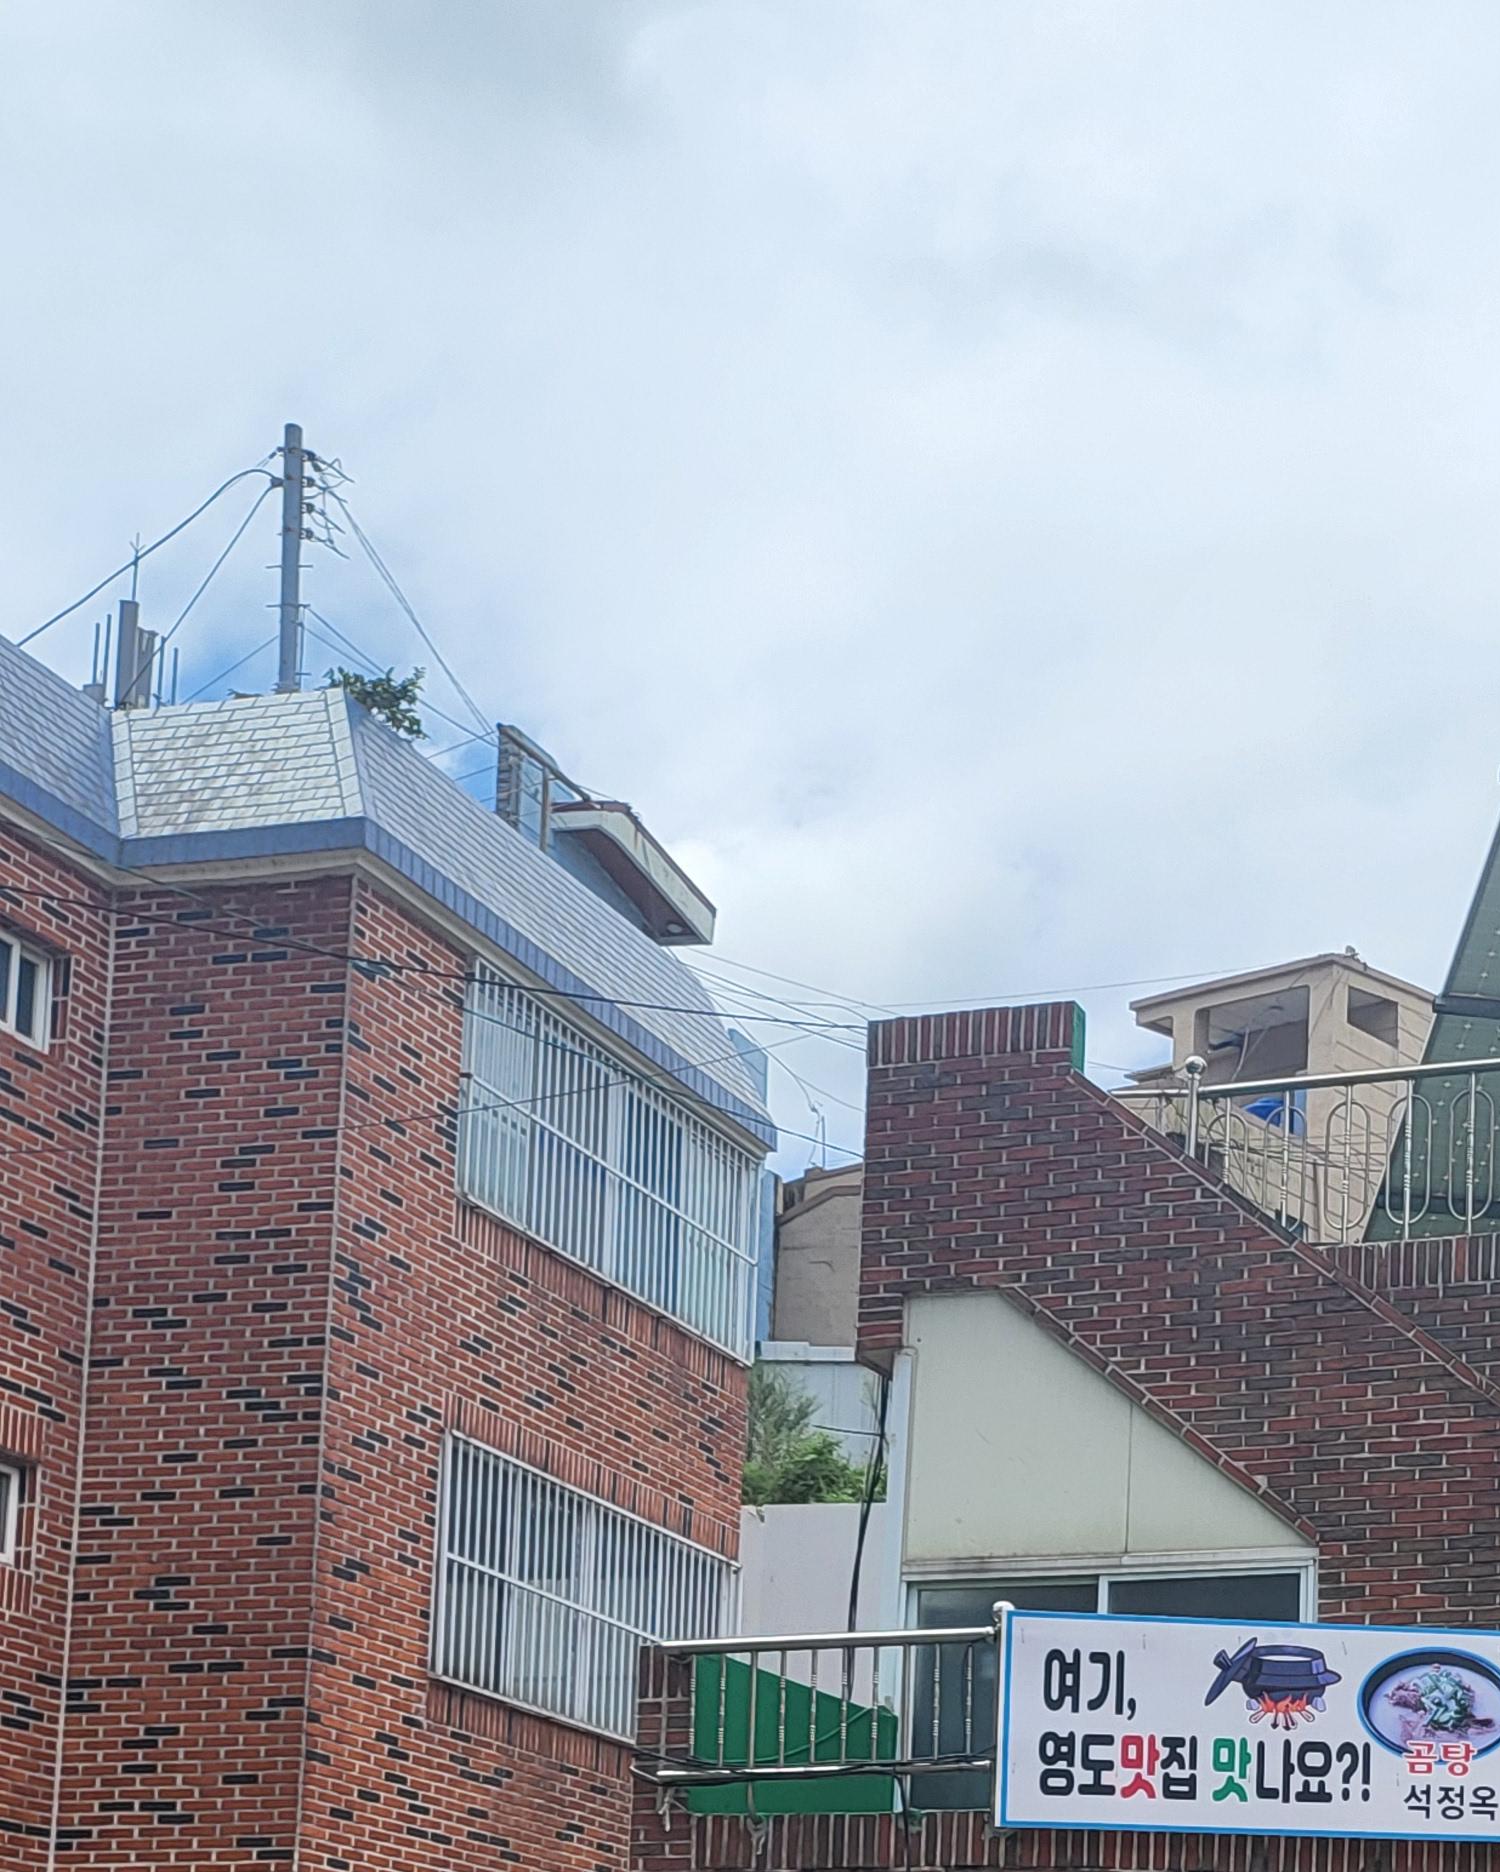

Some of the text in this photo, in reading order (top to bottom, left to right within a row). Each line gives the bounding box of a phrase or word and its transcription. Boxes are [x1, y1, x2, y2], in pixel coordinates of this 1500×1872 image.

[1043, 1648, 1137, 1721] 여기,
[1039, 1730, 1371, 1804] 영도맛집 맛나요?!
[1404, 1740, 1476, 1777] 곰탕
[1402, 1784, 1500, 1822] 석정옥
